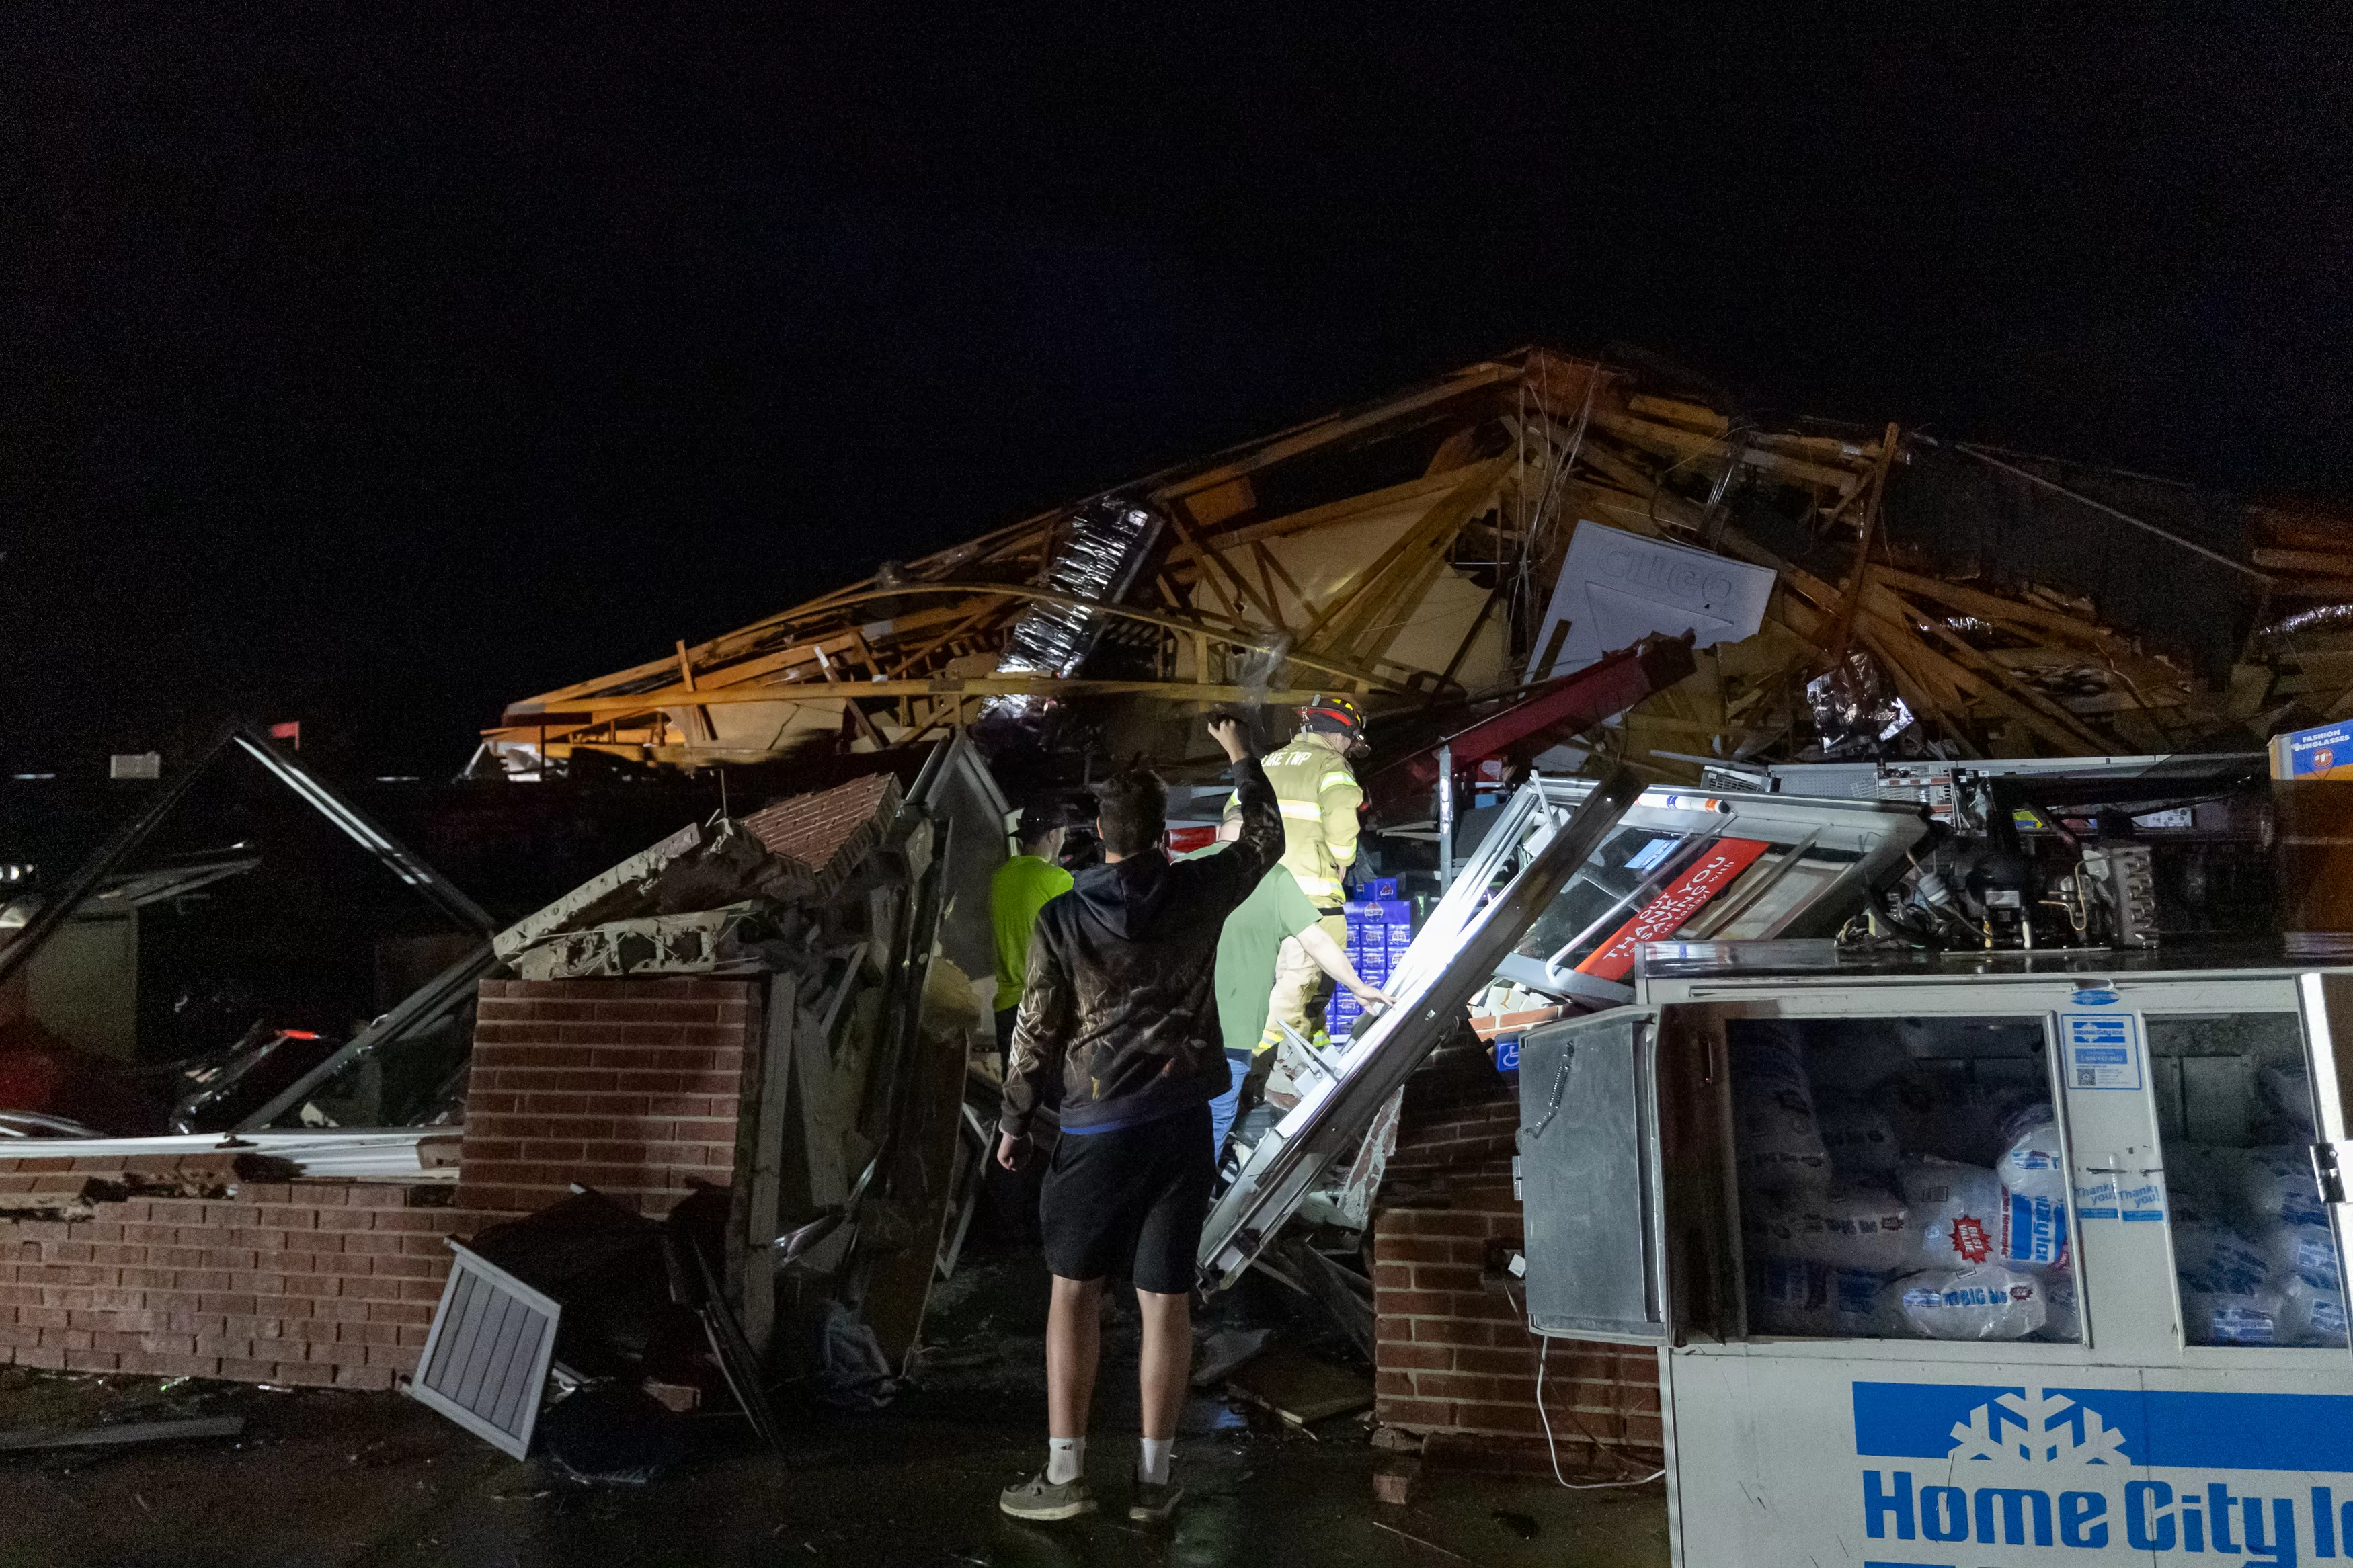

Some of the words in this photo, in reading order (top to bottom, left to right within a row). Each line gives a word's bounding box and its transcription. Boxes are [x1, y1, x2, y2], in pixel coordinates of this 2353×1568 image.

[2303, 729, 2340, 743] FASHION
[1285, 751, 1312, 766] TWP
[1603, 899, 1679, 960] THANK
[1677, 856, 1726, 893] YOU
[1623, 947, 1635, 957] fo
[1640, 885, 1707, 940] SAVING
[1708, 862, 1734, 882] with
[1639, 892, 1669, 919] OUT
[2075, 1183, 2110, 1197] Thank
[2091, 1182, 2116, 1206] you!
[2119, 1184, 2153, 1201] Thank
[2135, 1185, 2161, 1208] you!
[1958, 1224, 1975, 1253] VALUE
[1968, 1226, 1983, 1249] BEST
[1960, 1288, 1985, 1306] BIG
[1862, 1469, 2109, 1549] Home
[2124, 1480, 2299, 1568] City
